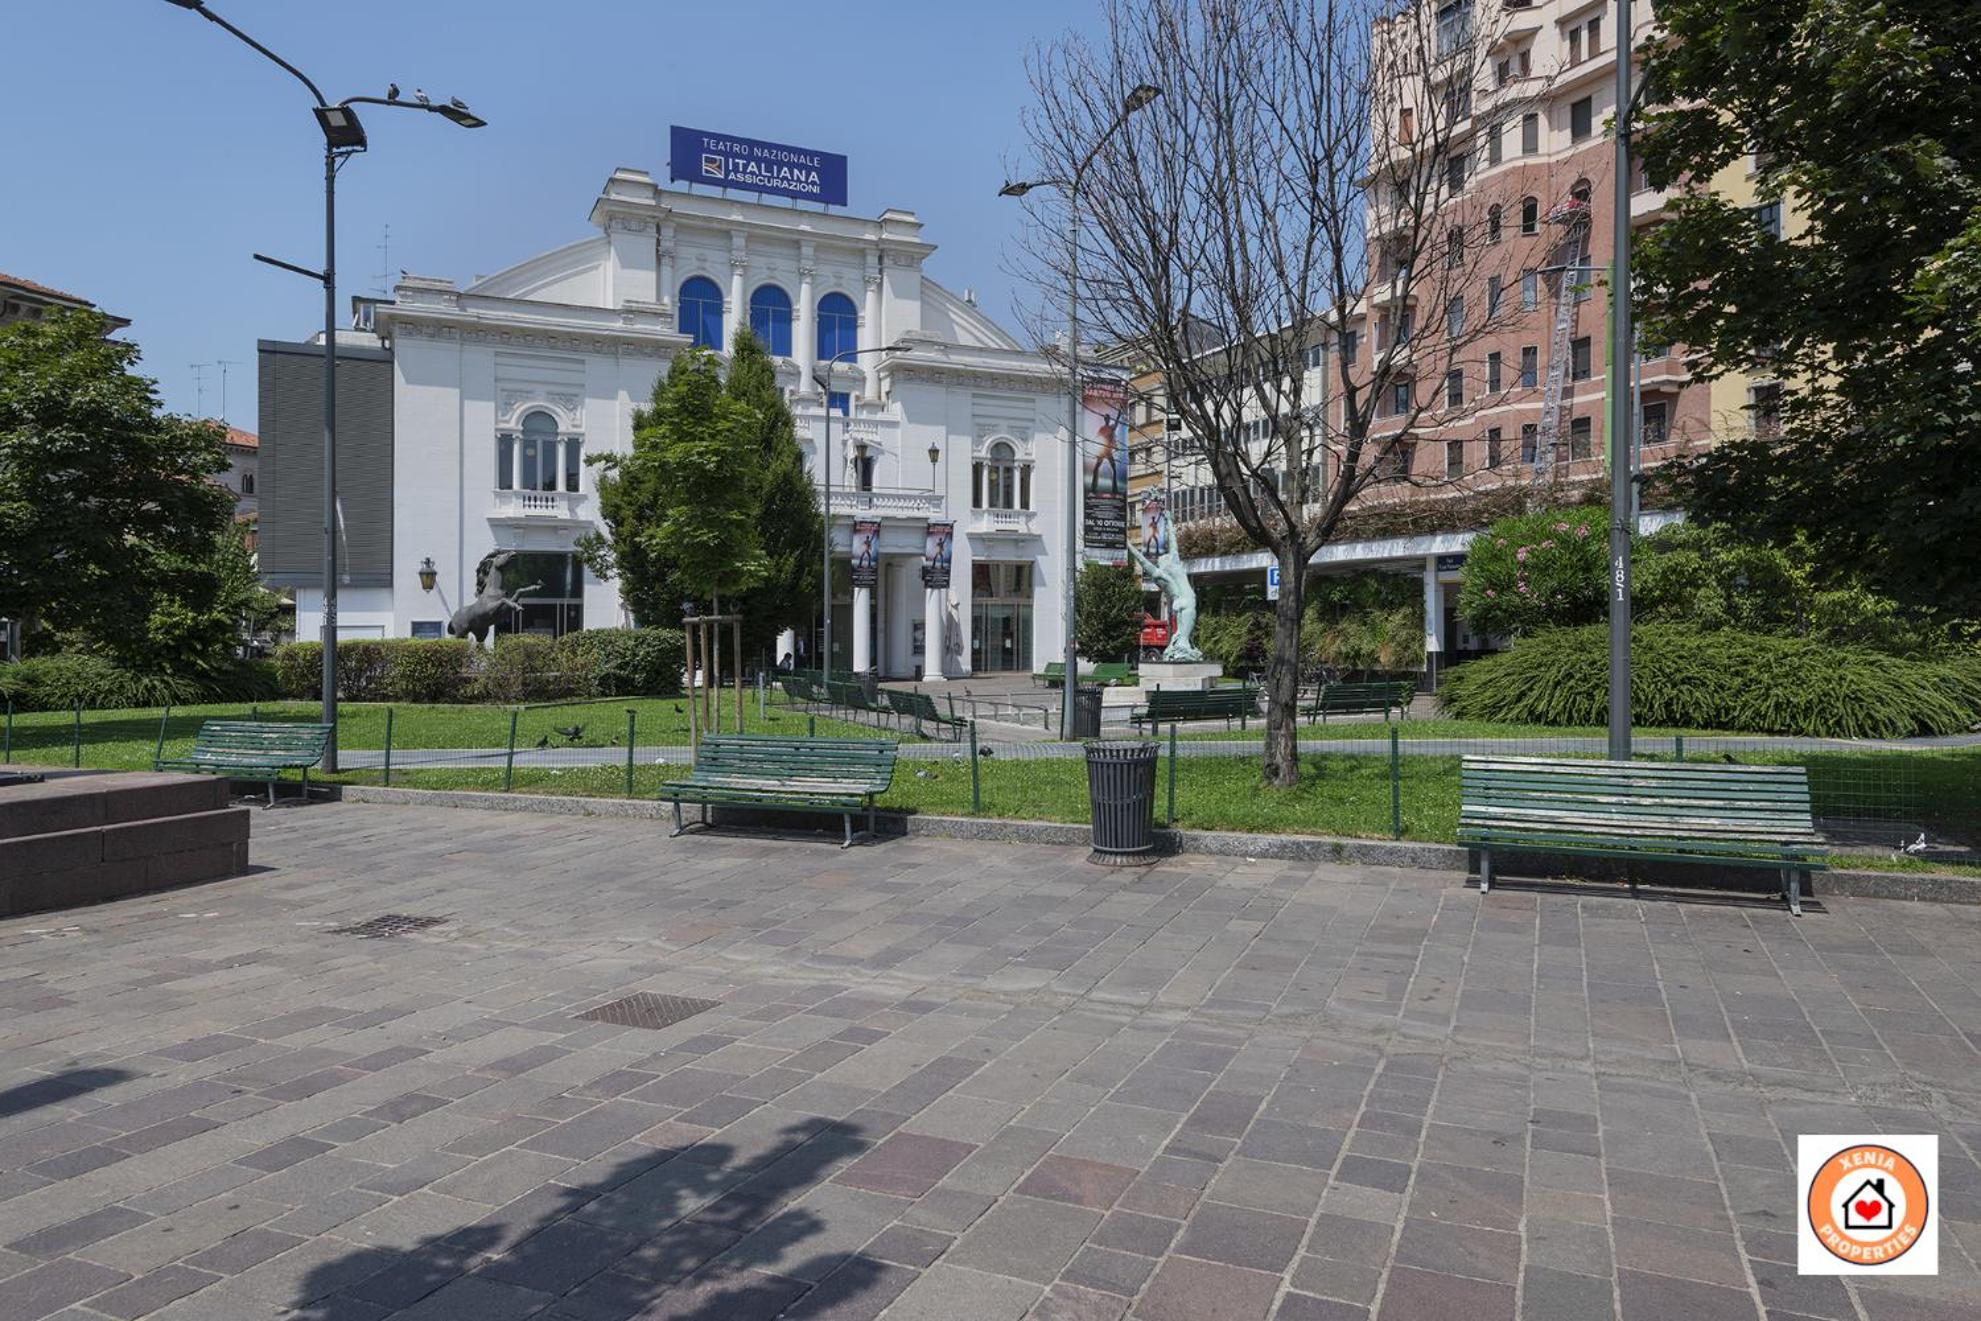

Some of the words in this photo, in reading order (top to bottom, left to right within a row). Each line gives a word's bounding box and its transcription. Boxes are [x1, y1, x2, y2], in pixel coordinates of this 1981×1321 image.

[702, 137, 749, 155] TEATRO
[753, 147, 821, 168] NAZIONALE
[728, 158, 820, 184] ITALIANA
[728, 171, 820, 194] ASSICURAZIONI
